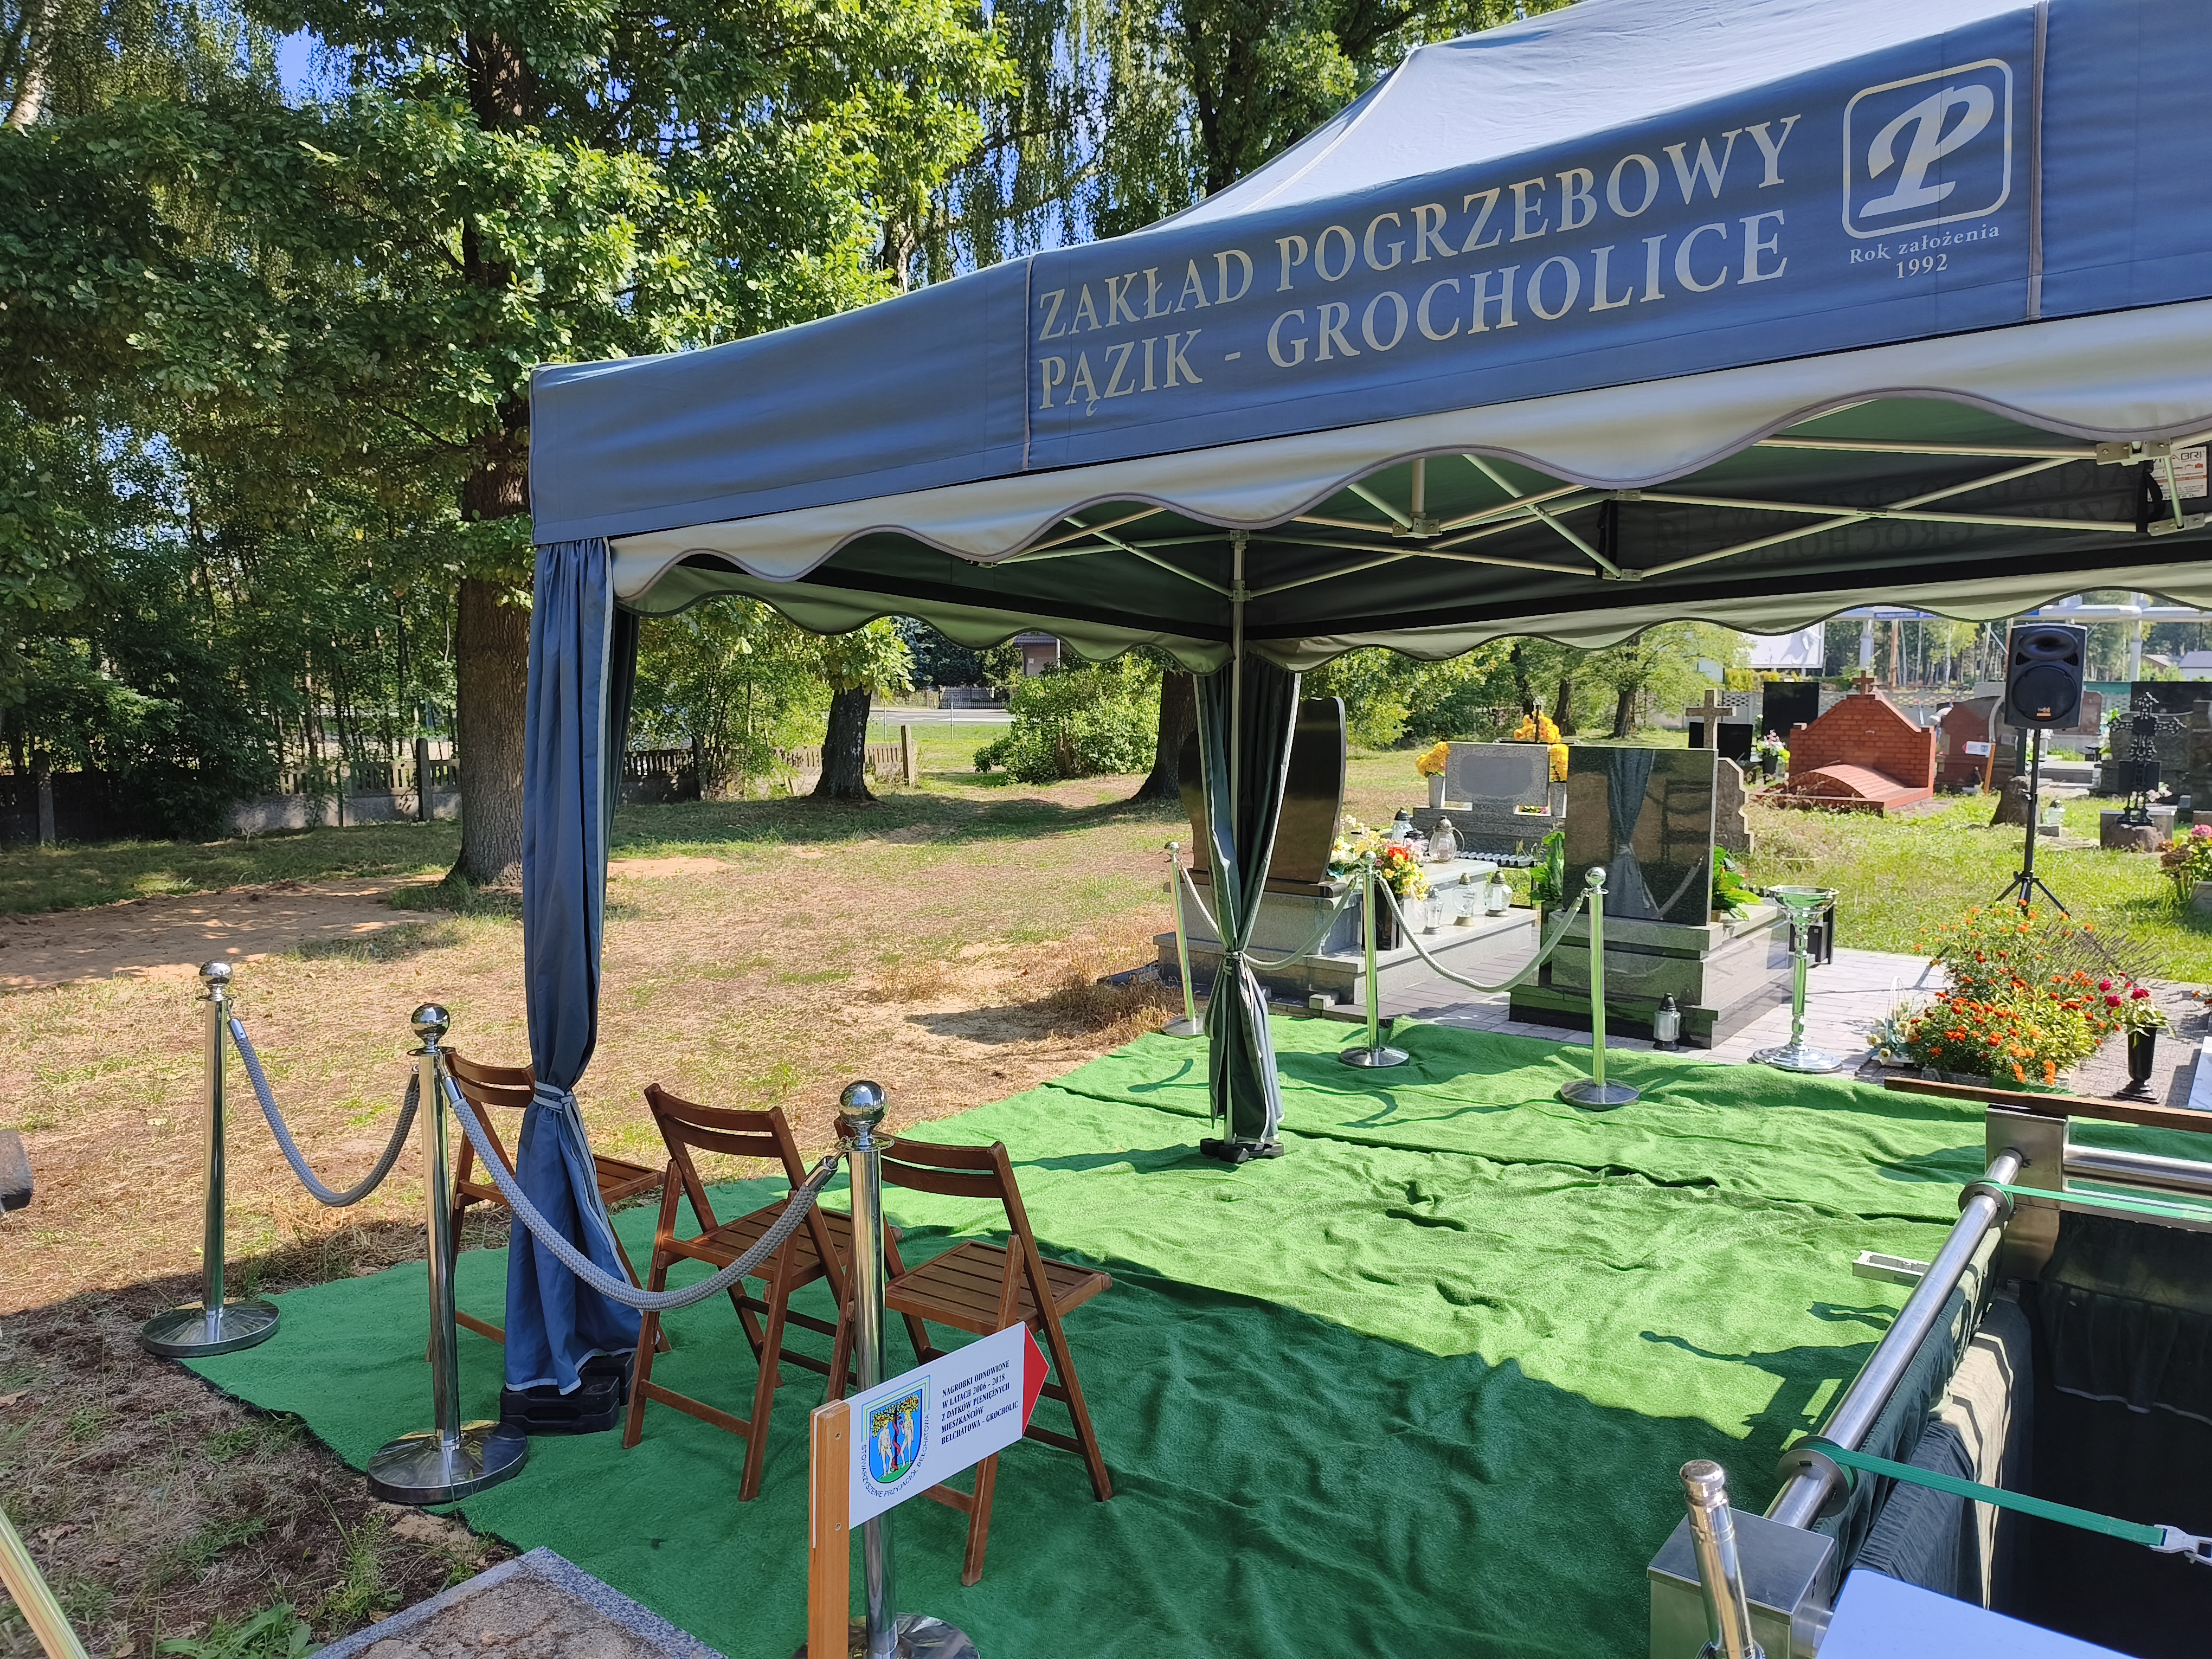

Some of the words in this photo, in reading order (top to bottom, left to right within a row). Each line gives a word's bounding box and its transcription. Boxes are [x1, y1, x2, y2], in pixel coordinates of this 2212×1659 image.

[1038, 249, 1254, 341] ZAKŁAD
[1275, 113, 1802, 293] POGRZEBOWY
[1849, 243, 1892, 264] Rok
[1898, 224, 1999, 255] założenia
[1896, 254, 1948, 279] 1992
[1039, 329, 1203, 417] PĄZIK
[1266, 209, 1787, 368] GROCHOLICE
[942, 1377, 973, 1398] NAGROBKI
[974, 1360, 1009, 1382] ODNOWIONE
[950, 1390, 971, 1406] LATACH
[973, 1382, 986, 1395] 2006
[992, 1373, 1005, 1386] 2018
[942, 1413, 946, 1422] Z
[947, 1400, 972, 1418] DATKÓW
[973, 1382, 1009, 1406] PIENIĘŻNYCH
[942, 1406, 984, 1433] MIESZKAŃCÓW
[986, 1400, 1018, 1422] GROCHOLIC
[861, 1444, 883, 1497] STOWARZYSZENIE
[884, 1470, 918, 1497] PRZYJACIÓŁ
